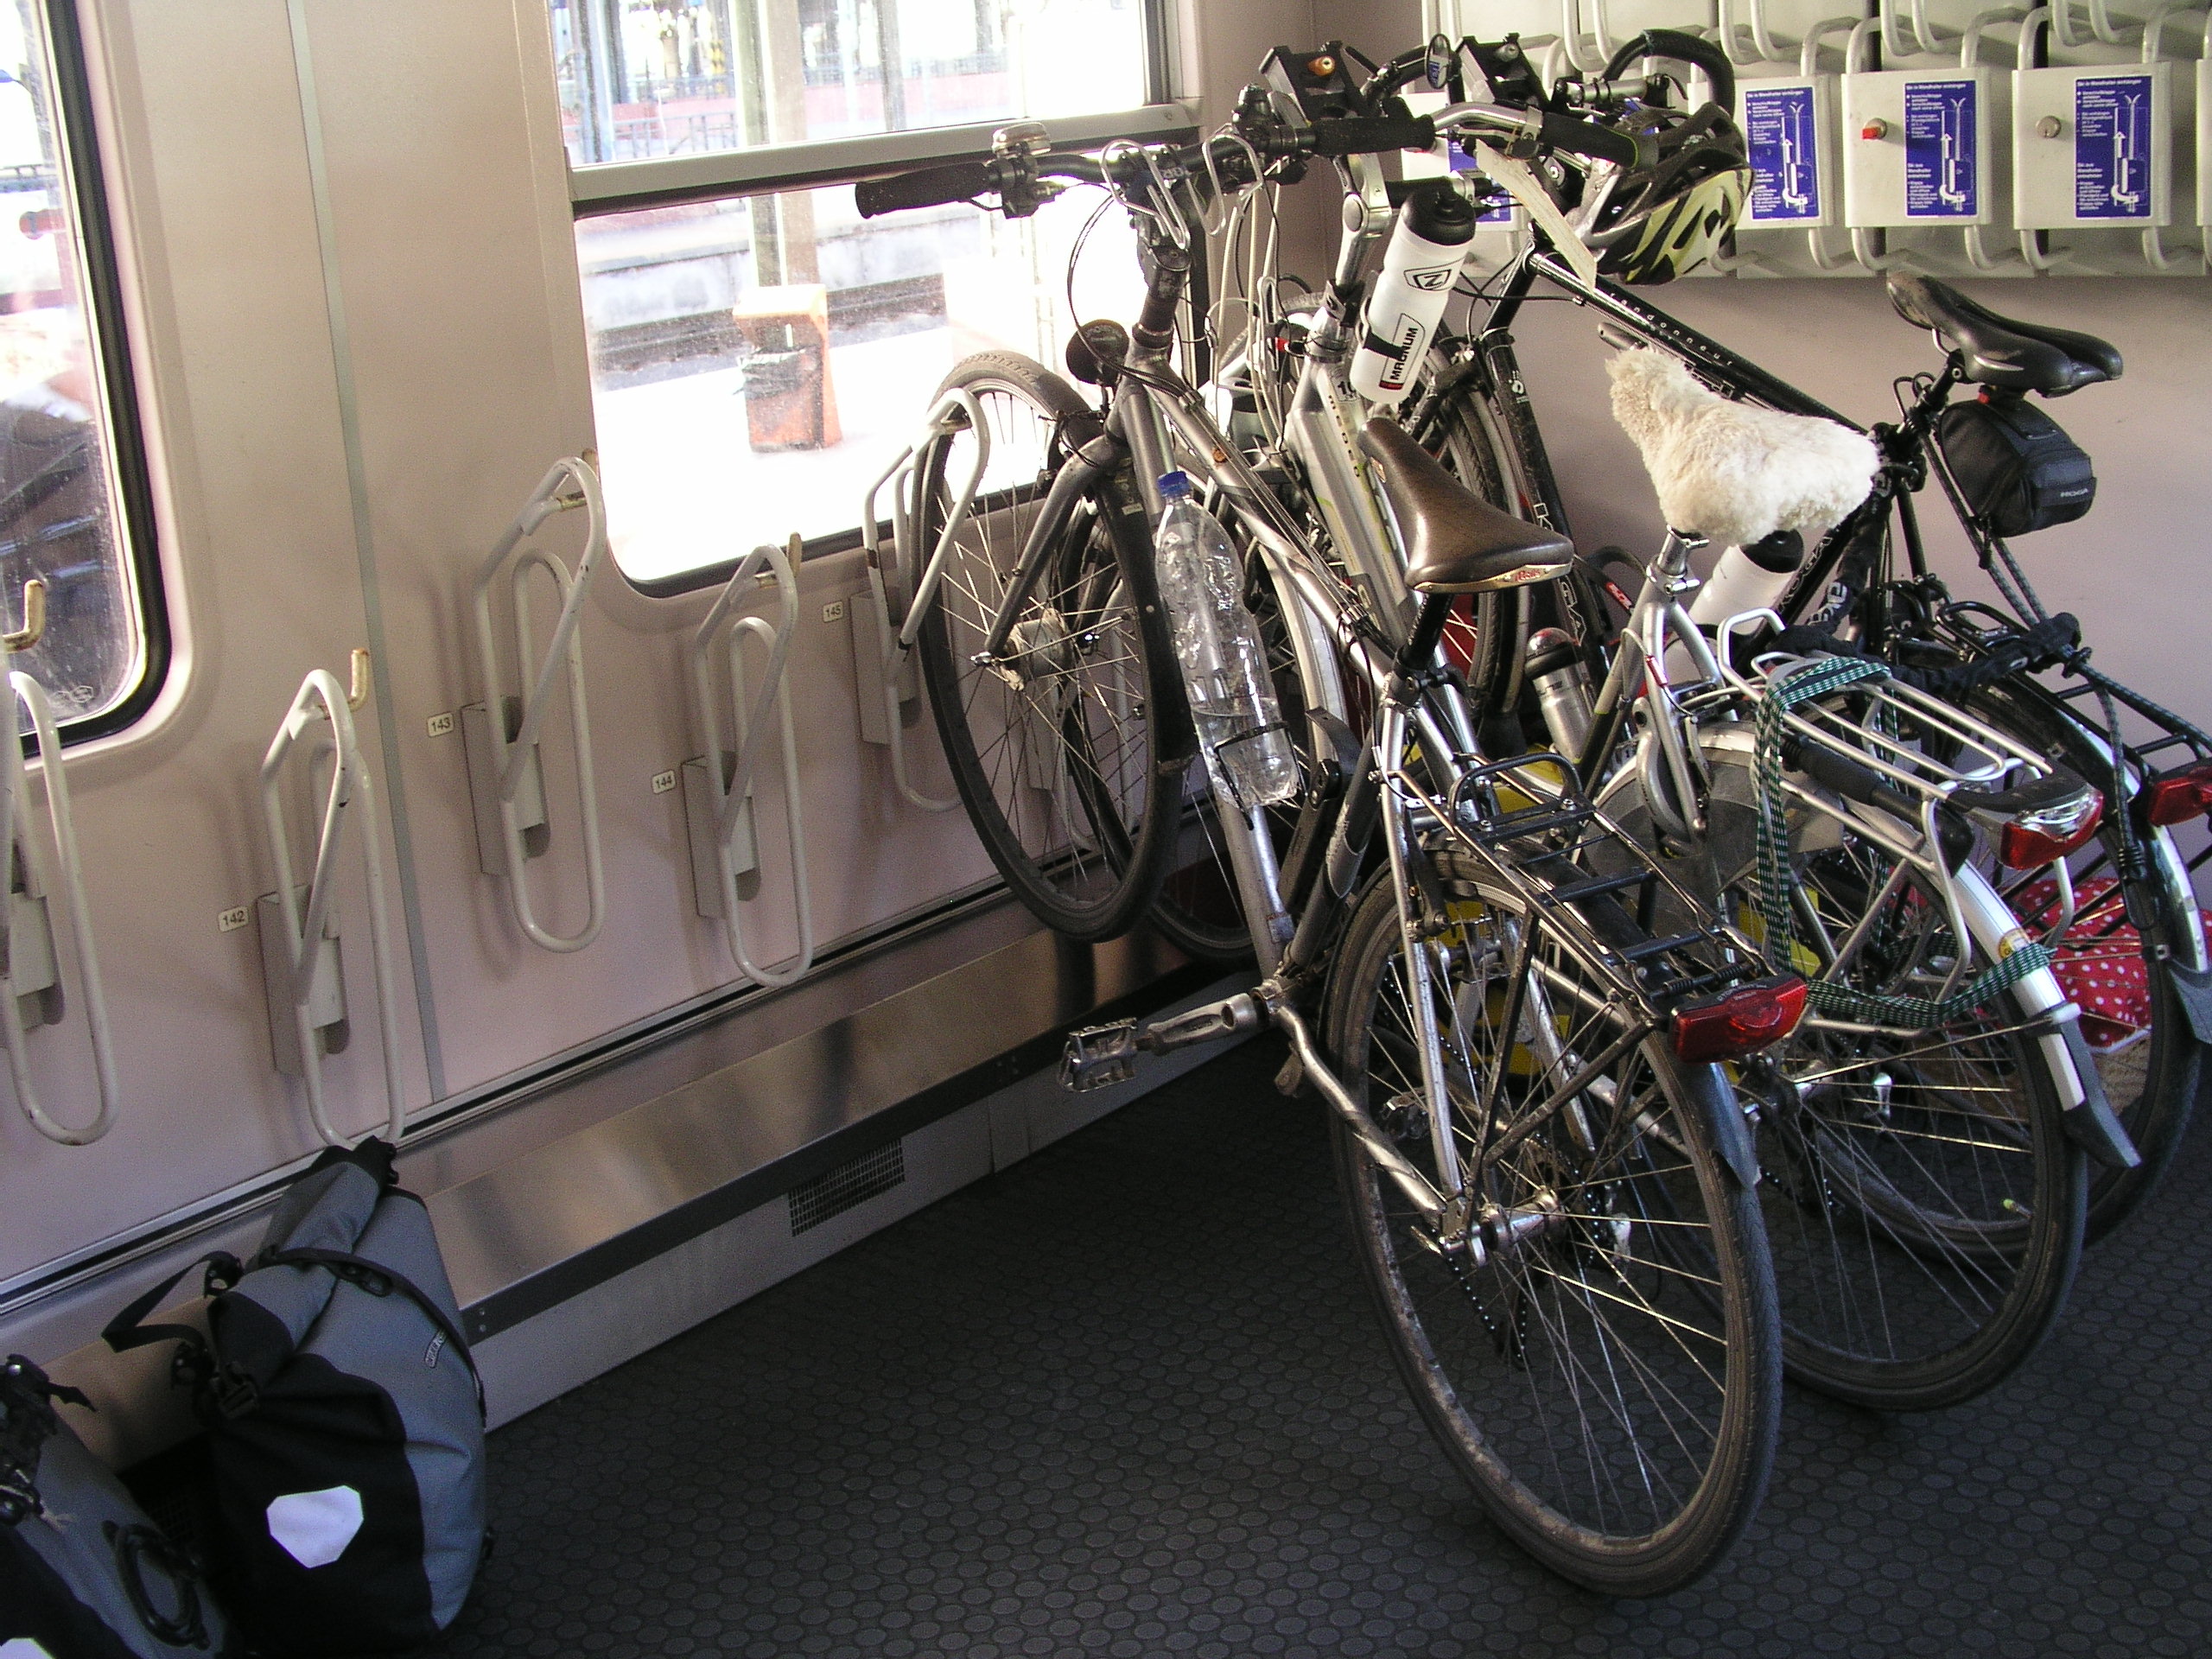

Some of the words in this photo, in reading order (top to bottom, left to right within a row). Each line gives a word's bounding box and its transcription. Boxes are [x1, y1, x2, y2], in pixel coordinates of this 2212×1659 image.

[1609, 292, 1733, 366] randonneur
[824, 605, 842, 620] 145
[430, 716, 451, 732] 143
[655, 774, 673, 788] 144
[222, 911, 245, 925] 142
